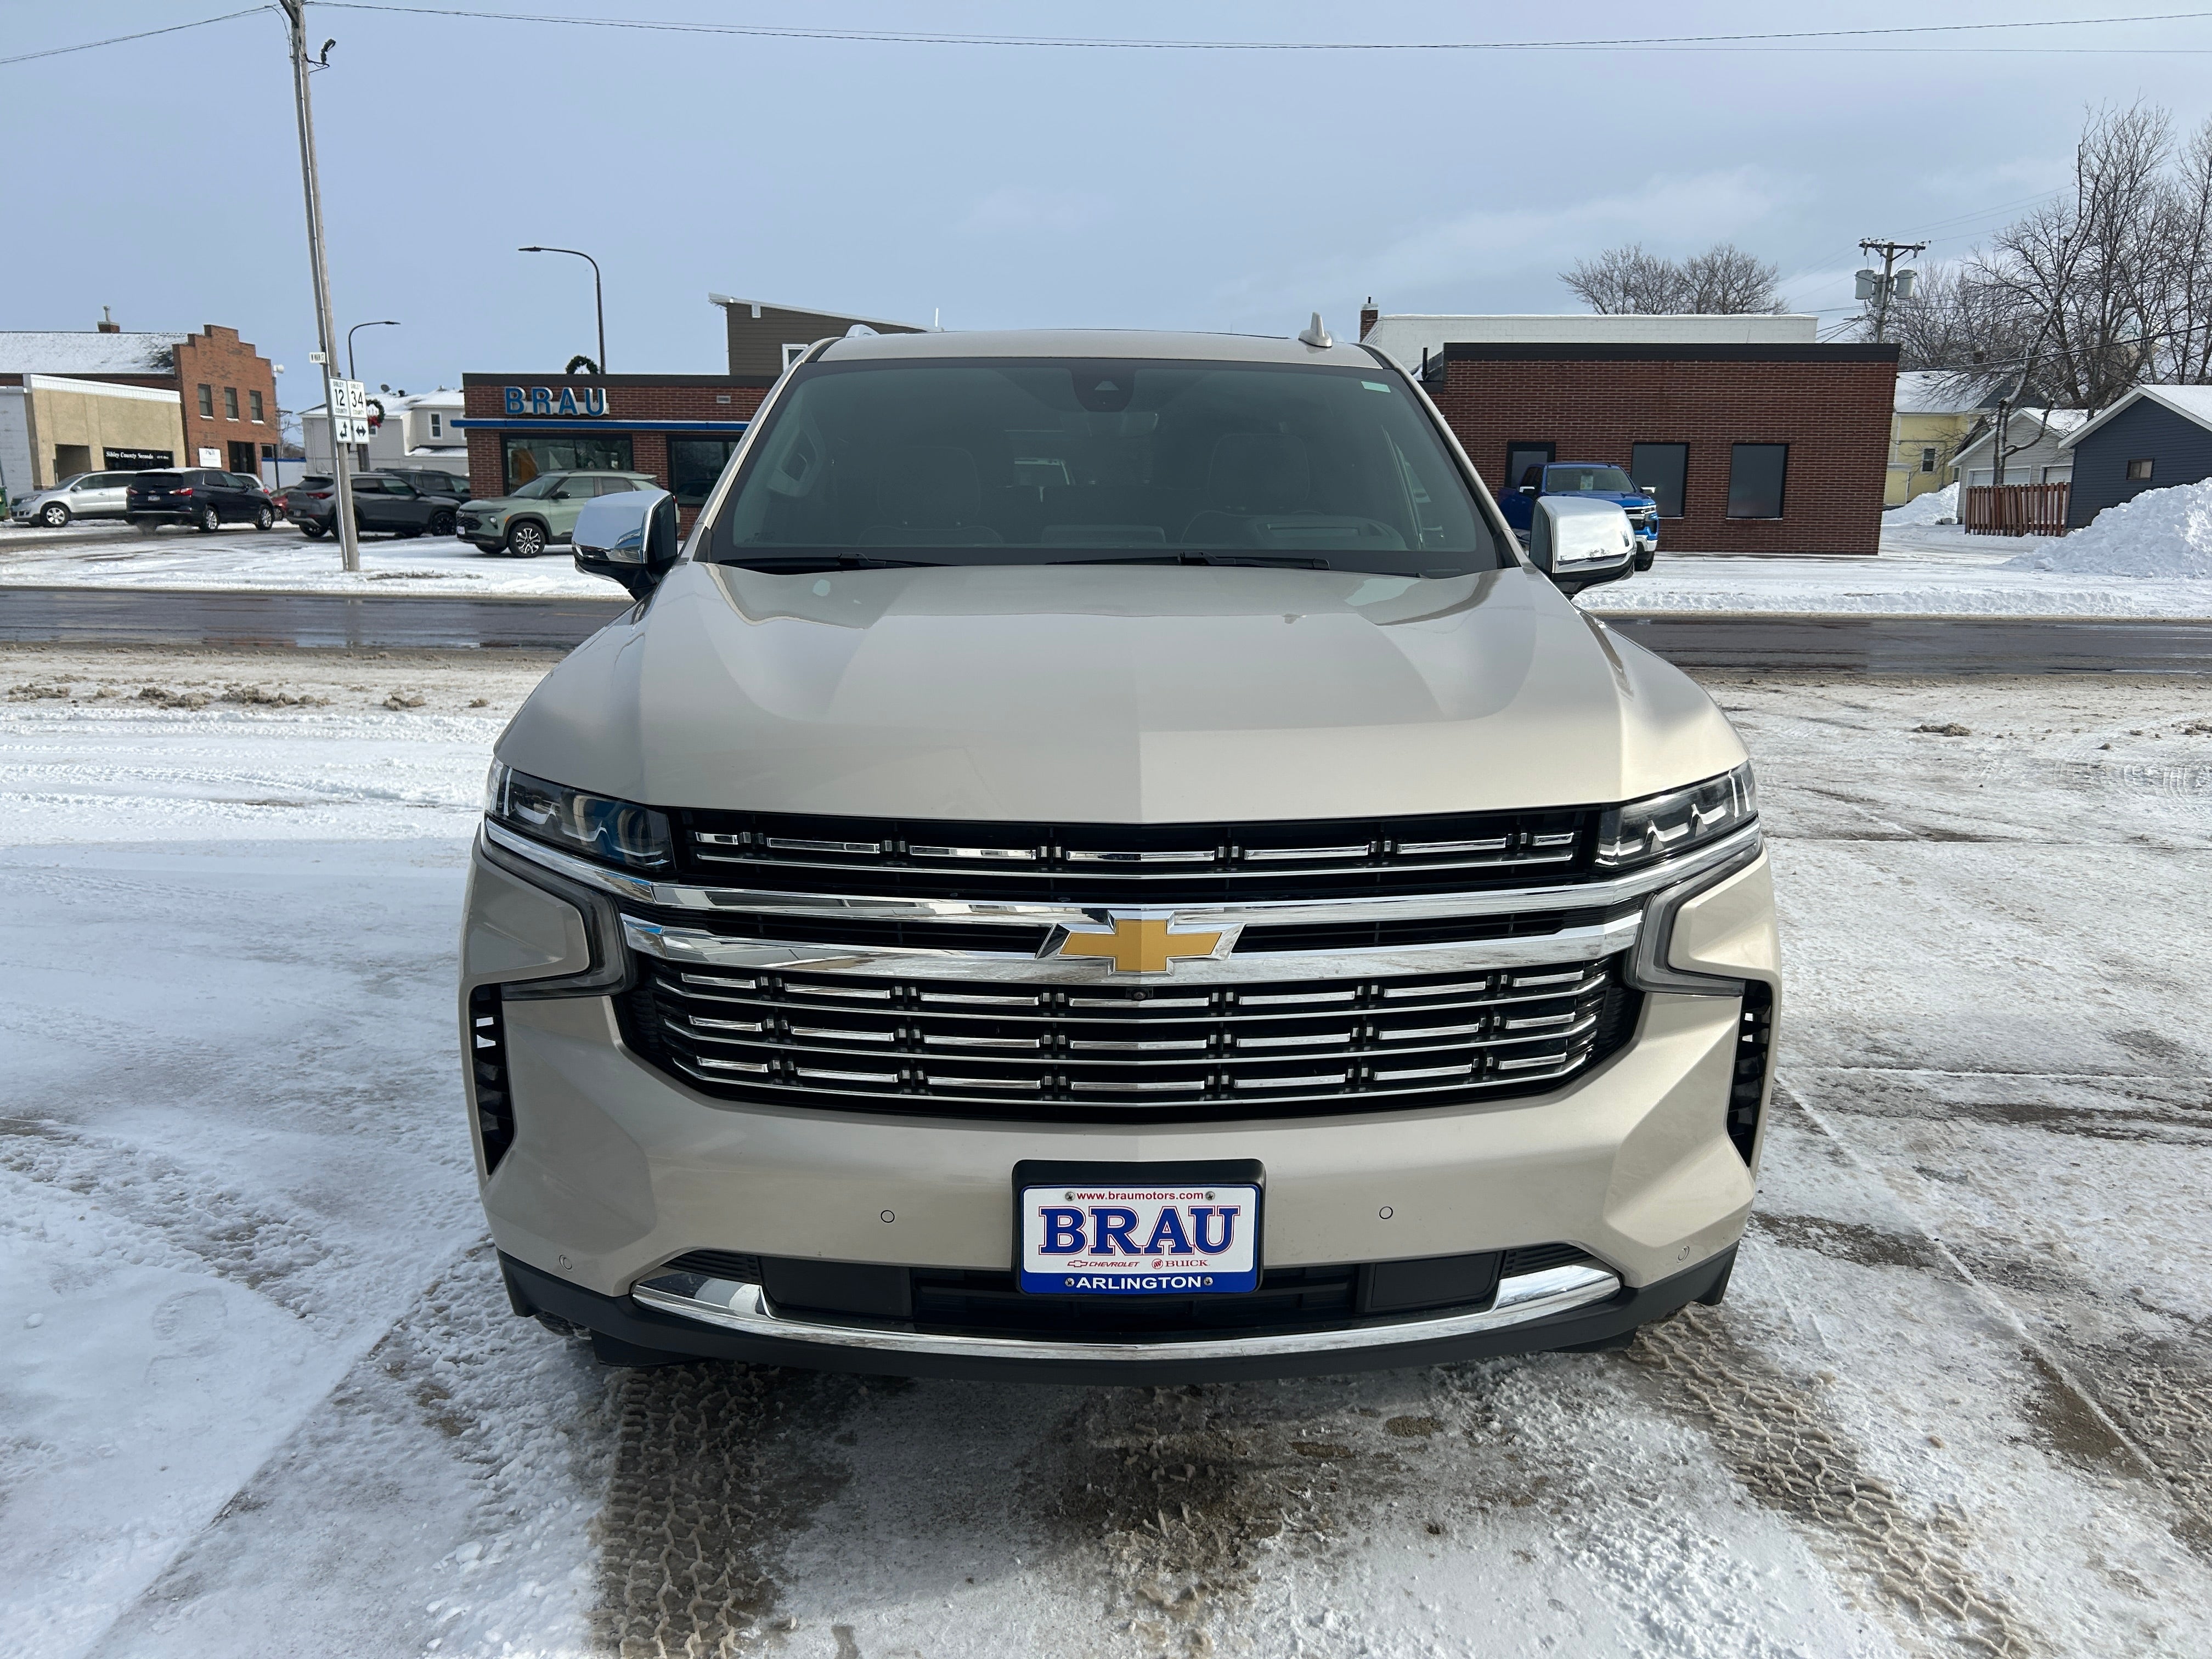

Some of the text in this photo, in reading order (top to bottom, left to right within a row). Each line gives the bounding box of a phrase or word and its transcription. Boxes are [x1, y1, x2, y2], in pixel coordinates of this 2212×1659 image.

[335, 388, 345, 407] 12
[351, 390, 363, 408] 34
[505, 386, 607, 417] BRAU
[120, 452, 137, 460] County
[1076, 1191, 1204, 1200] www.braumotors.com
[1038, 1205, 1241, 1256] BRAU
[1076, 1276, 1201, 1290] ARLINGTON
